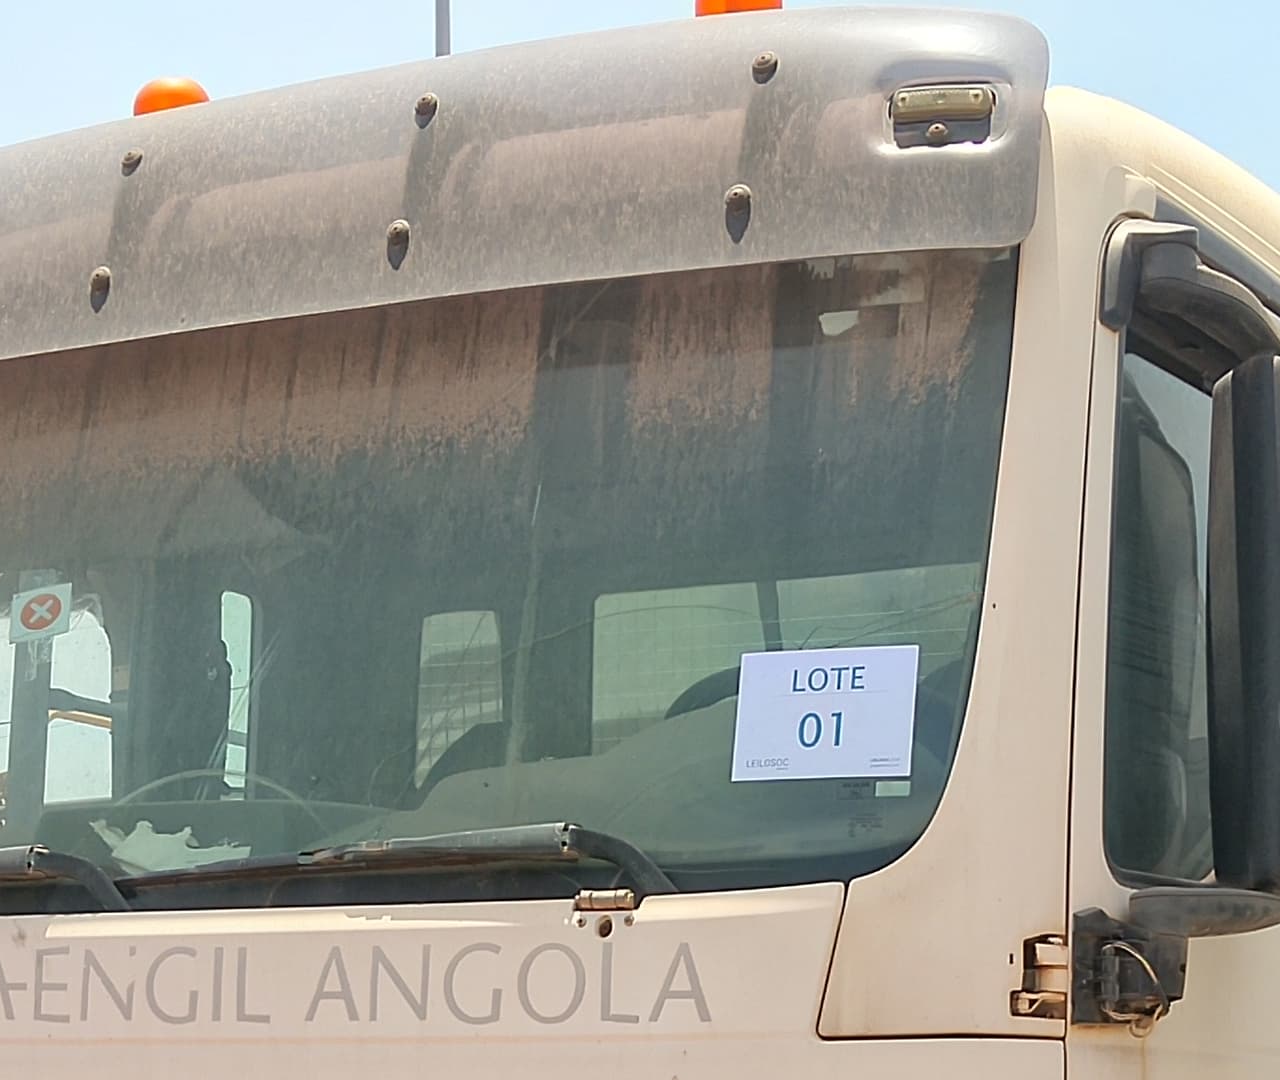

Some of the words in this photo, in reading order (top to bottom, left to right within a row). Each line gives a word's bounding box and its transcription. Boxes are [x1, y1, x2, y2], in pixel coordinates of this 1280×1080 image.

[791, 666, 866, 693] LOTE
[798, 711, 843, 749] 01
[303, 941, 712, 1025] ANGOLA
